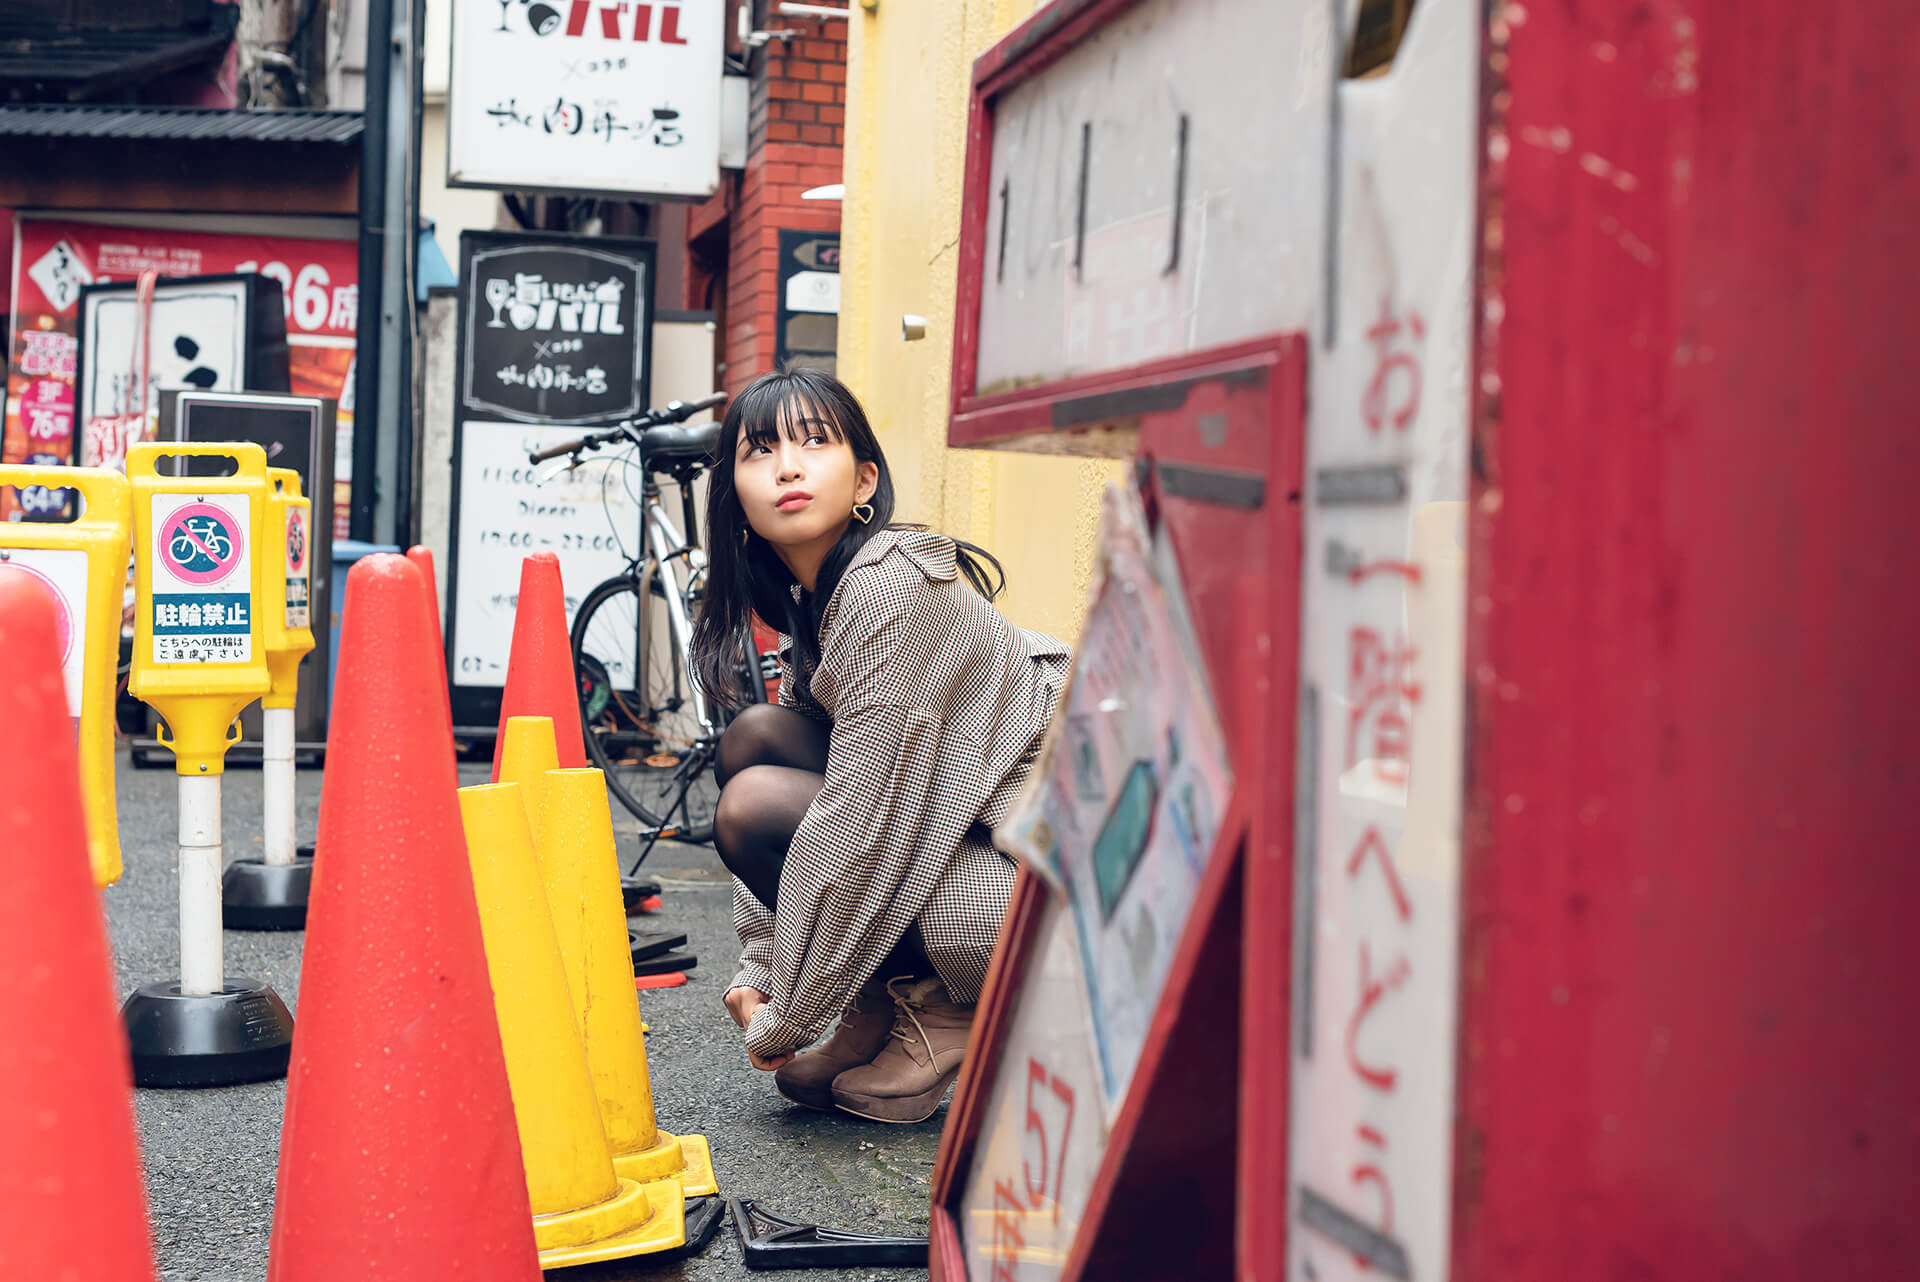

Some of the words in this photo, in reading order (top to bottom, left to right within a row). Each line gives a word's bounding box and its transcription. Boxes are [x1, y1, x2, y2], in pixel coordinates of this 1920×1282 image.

[155, 602, 248, 627] 駐輪禁止
[159, 637, 243, 648] こちらへの駐輪は
[159, 649, 244, 660] ご遠慮下さい
